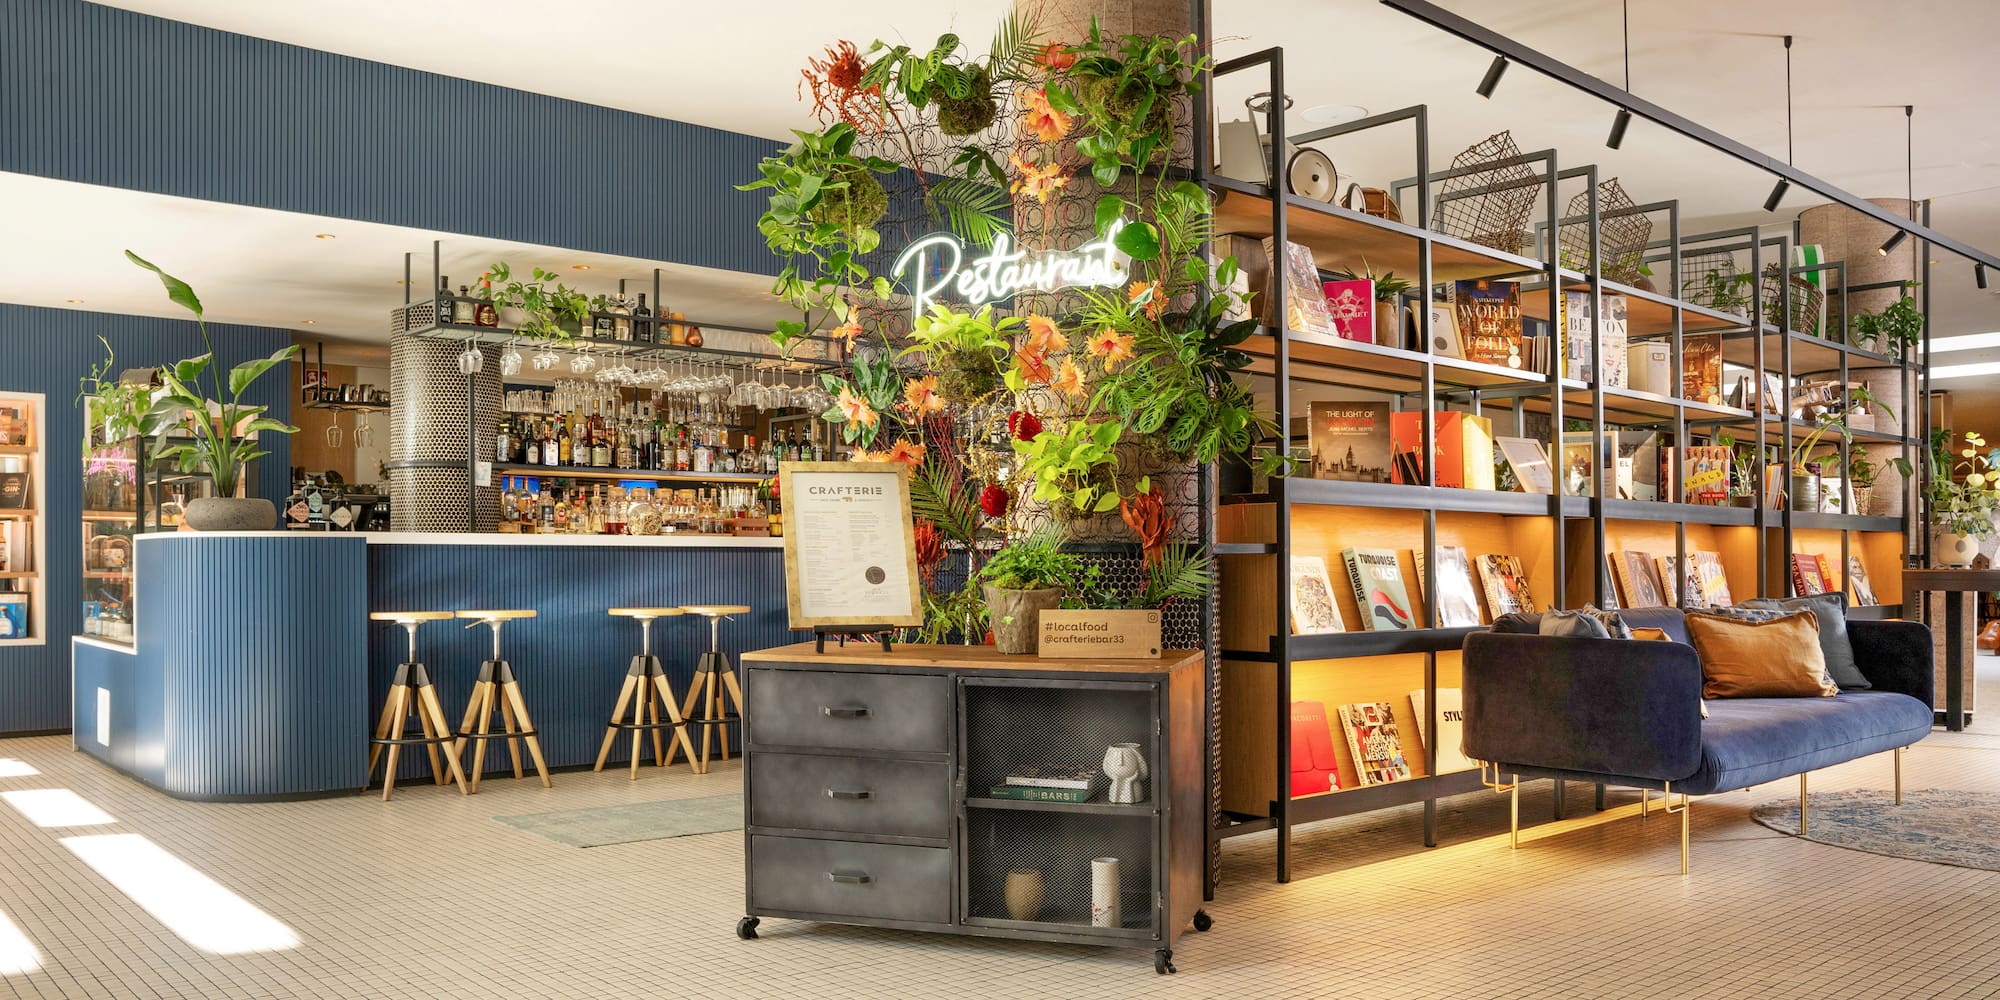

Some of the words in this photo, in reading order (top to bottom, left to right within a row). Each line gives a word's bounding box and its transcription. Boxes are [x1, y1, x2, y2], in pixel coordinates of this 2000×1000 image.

[893, 216, 1128, 320] Restaurant
[1459, 304, 1520, 320] WORLD
[1480, 320, 1501, 335] OF
[1465, 336, 1513, 351] FOLLY
[1326, 410, 1341, 418] THE
[1341, 410, 1363, 418] LIGHT
[1364, 410, 1375, 418] OF
[808, 486, 884, 495] CRAFTERIE
[1358, 553, 1396, 567] TURQUOISE
[1347, 557, 1366, 603] TURQUOISE
[1045, 622, 1108, 632] #localfood
[1044, 635, 1125, 644] @crafteriebar33
[1443, 710, 1463, 722] STYL
[1041, 791, 1070, 801] BARS
